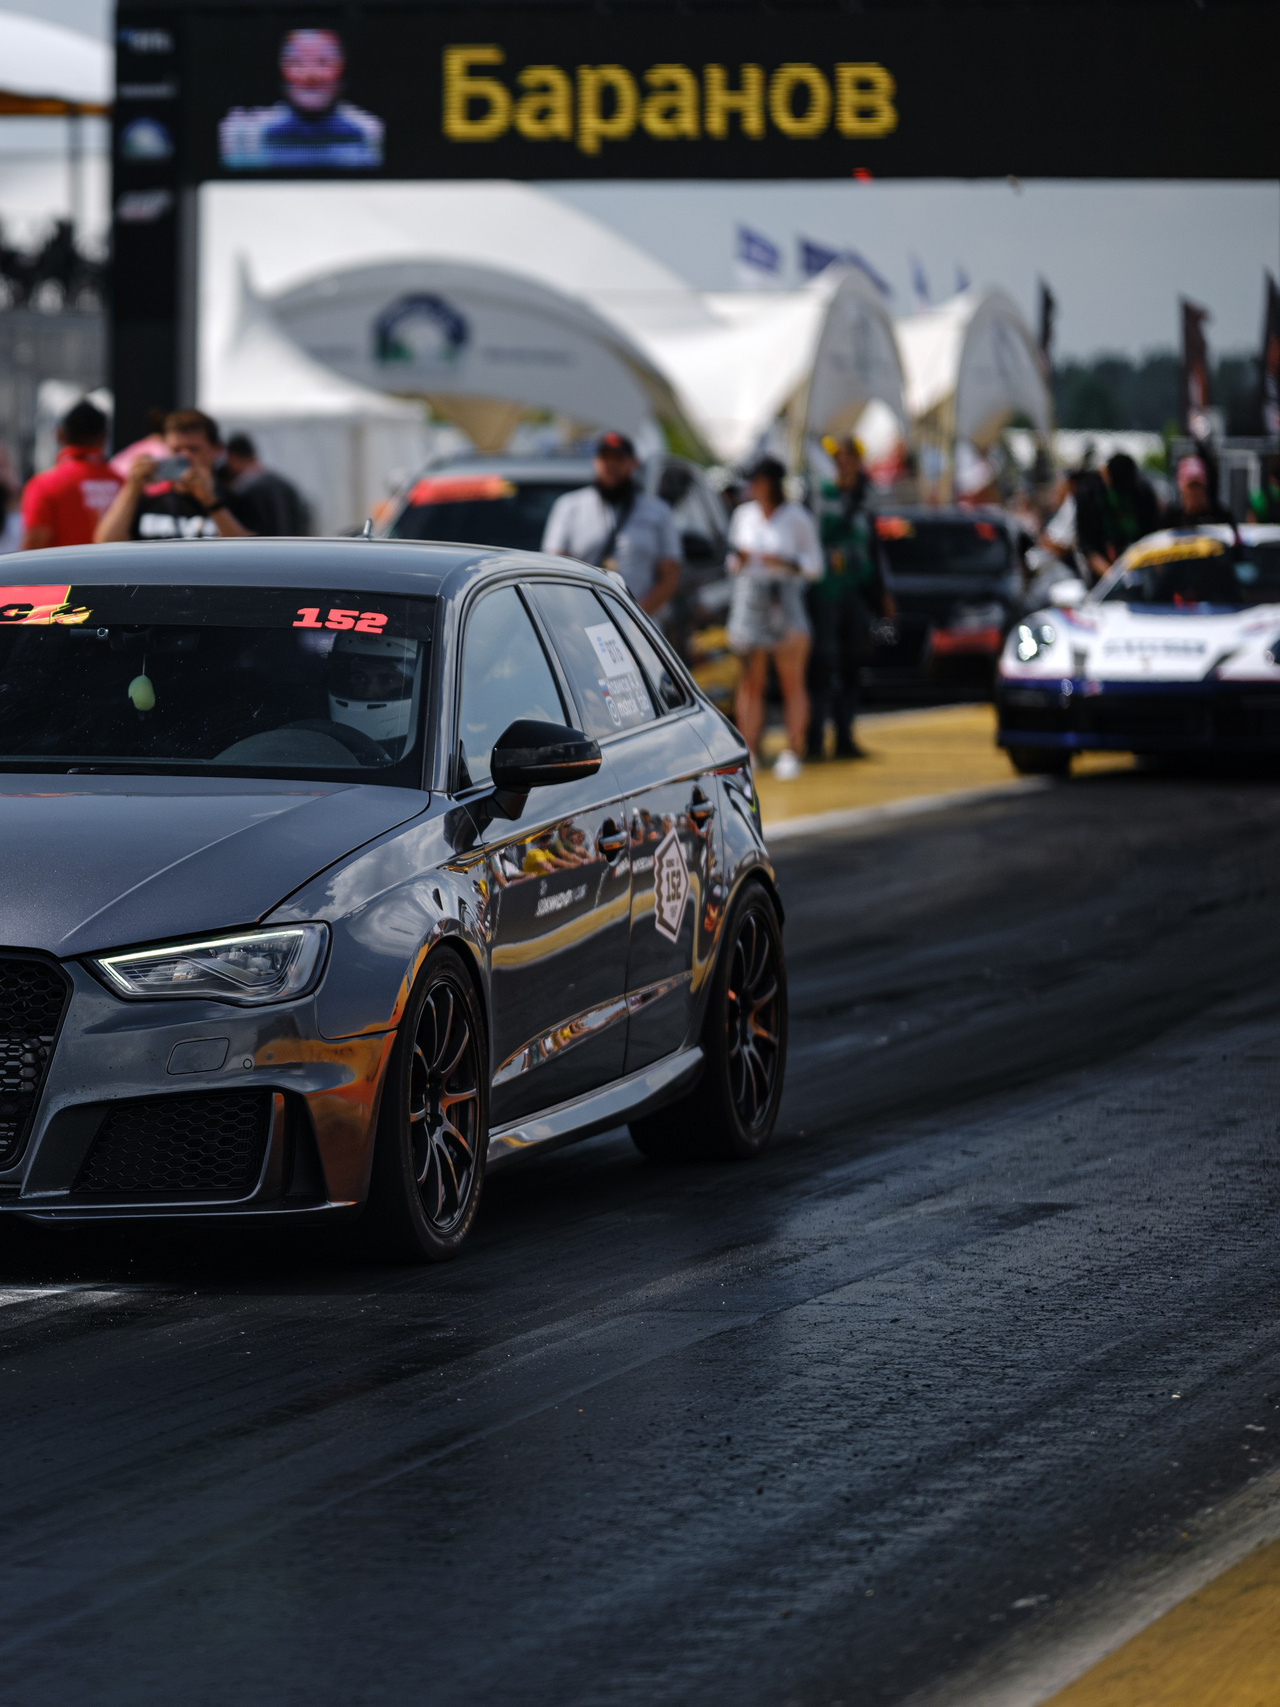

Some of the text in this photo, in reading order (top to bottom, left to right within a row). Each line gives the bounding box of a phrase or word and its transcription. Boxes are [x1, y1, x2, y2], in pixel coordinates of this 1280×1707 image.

[442, 43, 898, 156] Баранов
[292, 607, 389, 634] 152
[666, 868, 682, 902] 152
